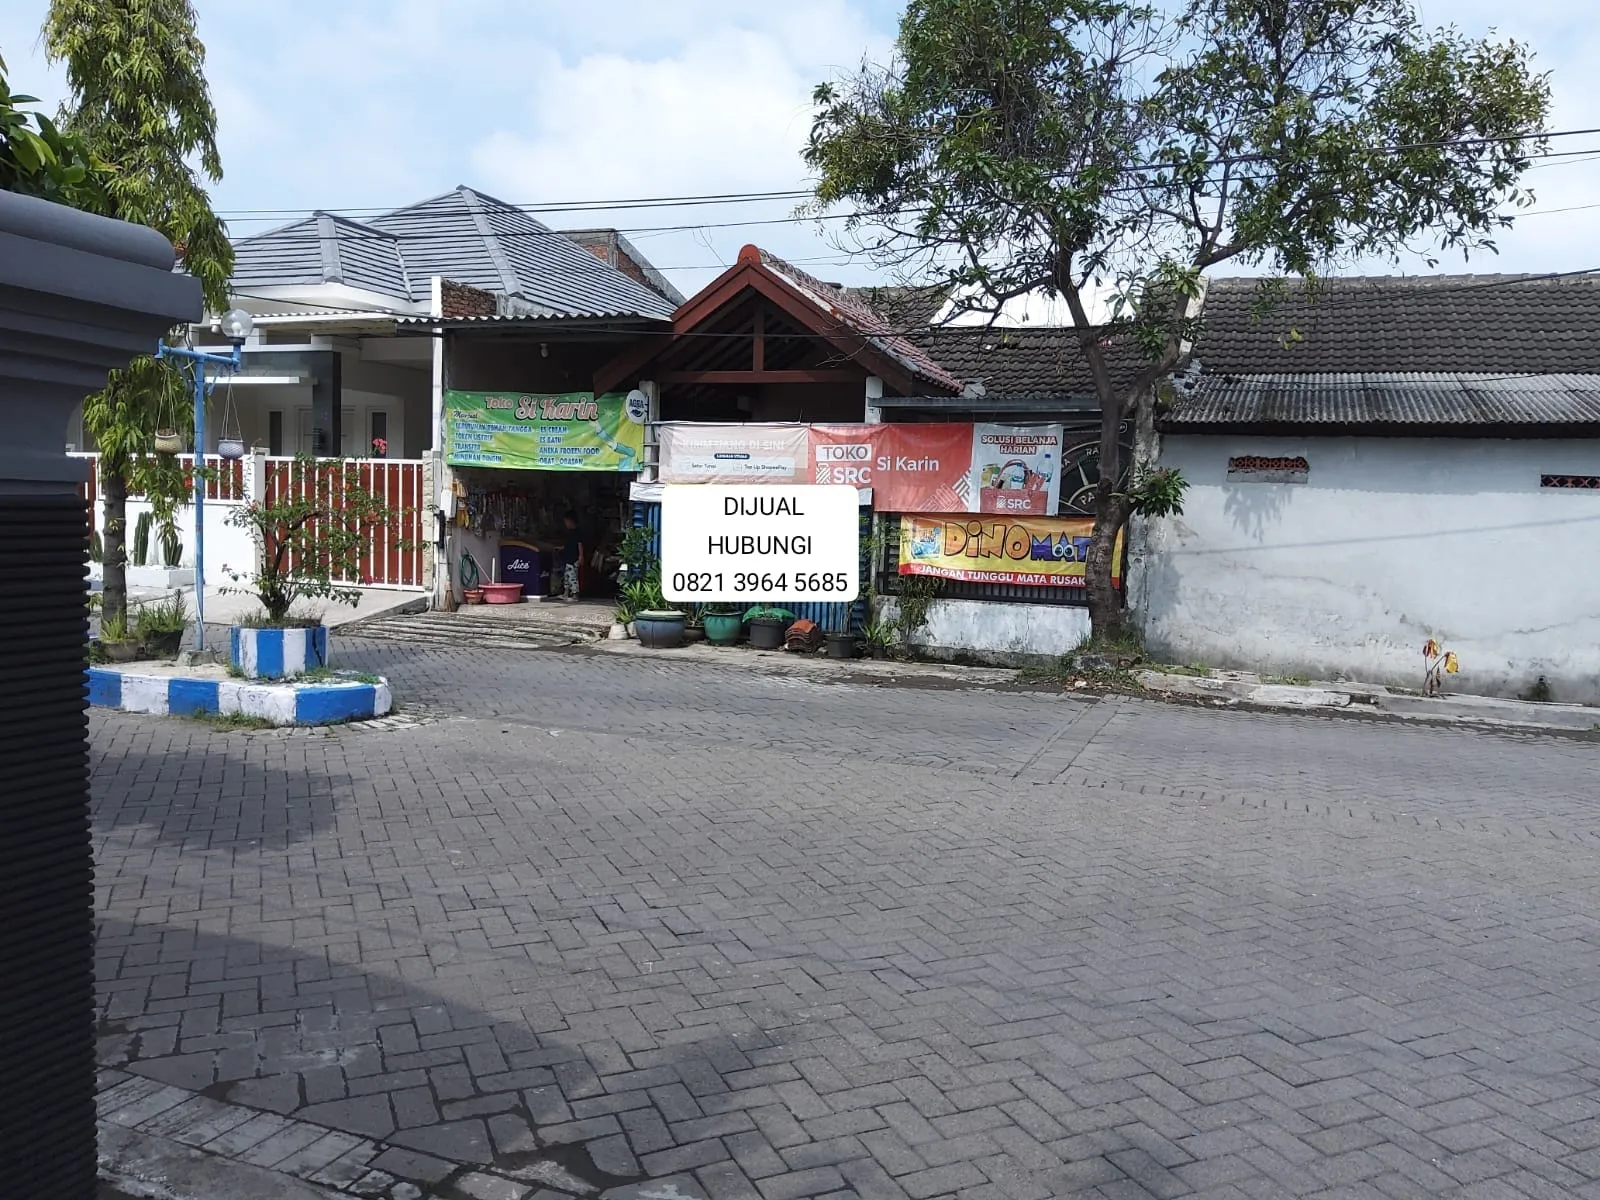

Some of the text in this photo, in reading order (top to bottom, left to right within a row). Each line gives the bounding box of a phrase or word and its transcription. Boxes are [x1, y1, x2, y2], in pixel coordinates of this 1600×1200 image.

[486, 396, 598, 420] Toko Si Karin
[508, 425, 532, 433] TANGGA
[455, 432, 474, 440] TOKEN
[982, 435, 1057, 446] SOLUSI BELANJA
[583, 447, 600, 455] FOOD
[823, 446, 868, 460] TOKO
[1000, 445, 1036, 455] HARIAN
[453, 453, 480, 461] MINUMAN
[877, 456, 939, 471] Si Karin
[833, 467, 871, 484] SRC
[1008, 499, 1031, 510] SRC
[507, 559, 530, 570] Aice
[921, 564, 965, 580] JANGAN
[967, 571, 1014, 582] TUNGGU
[1017, 573, 1047, 584] MATA
[1050, 575, 1086, 586] RUSAK
